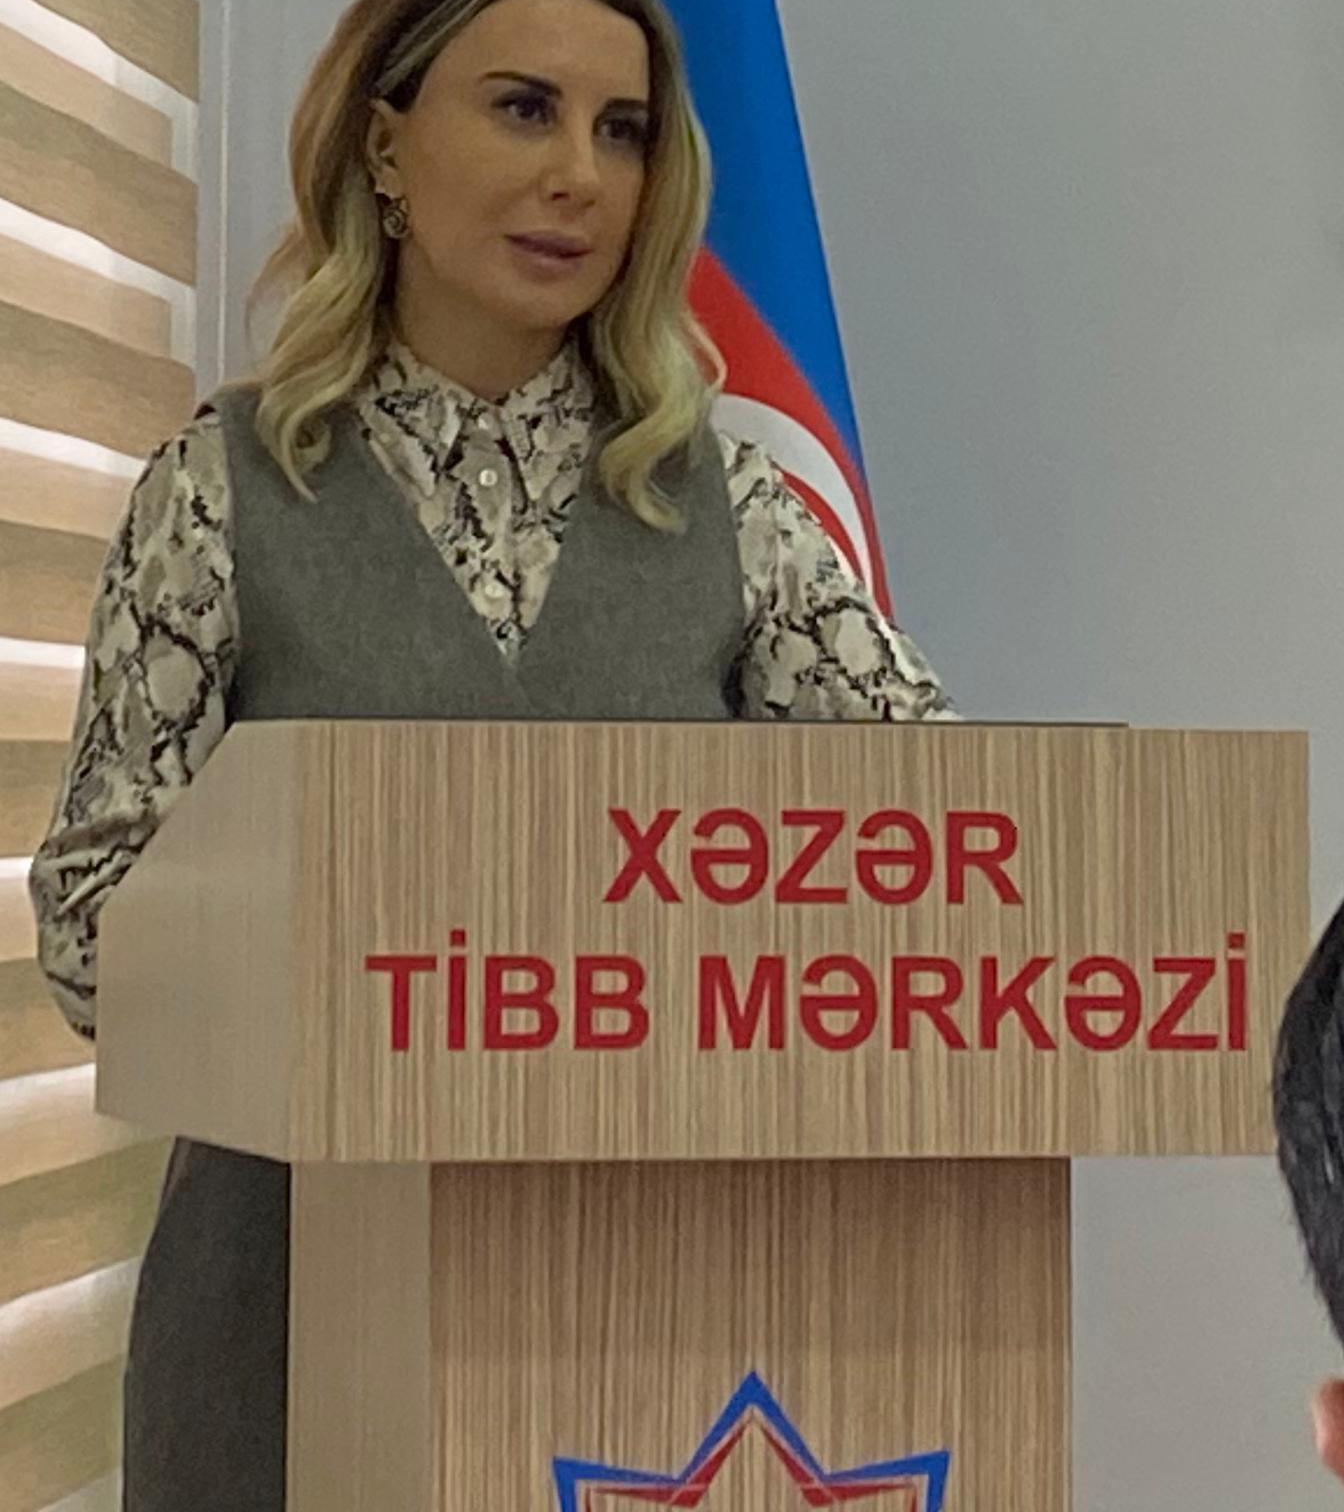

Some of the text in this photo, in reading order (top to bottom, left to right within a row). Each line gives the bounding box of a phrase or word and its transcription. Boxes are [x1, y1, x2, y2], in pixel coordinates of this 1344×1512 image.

[604, 809, 1024, 905] XƏZƏR
[365, 929, 1248, 1051] TİBB MƏRKƏZİ
